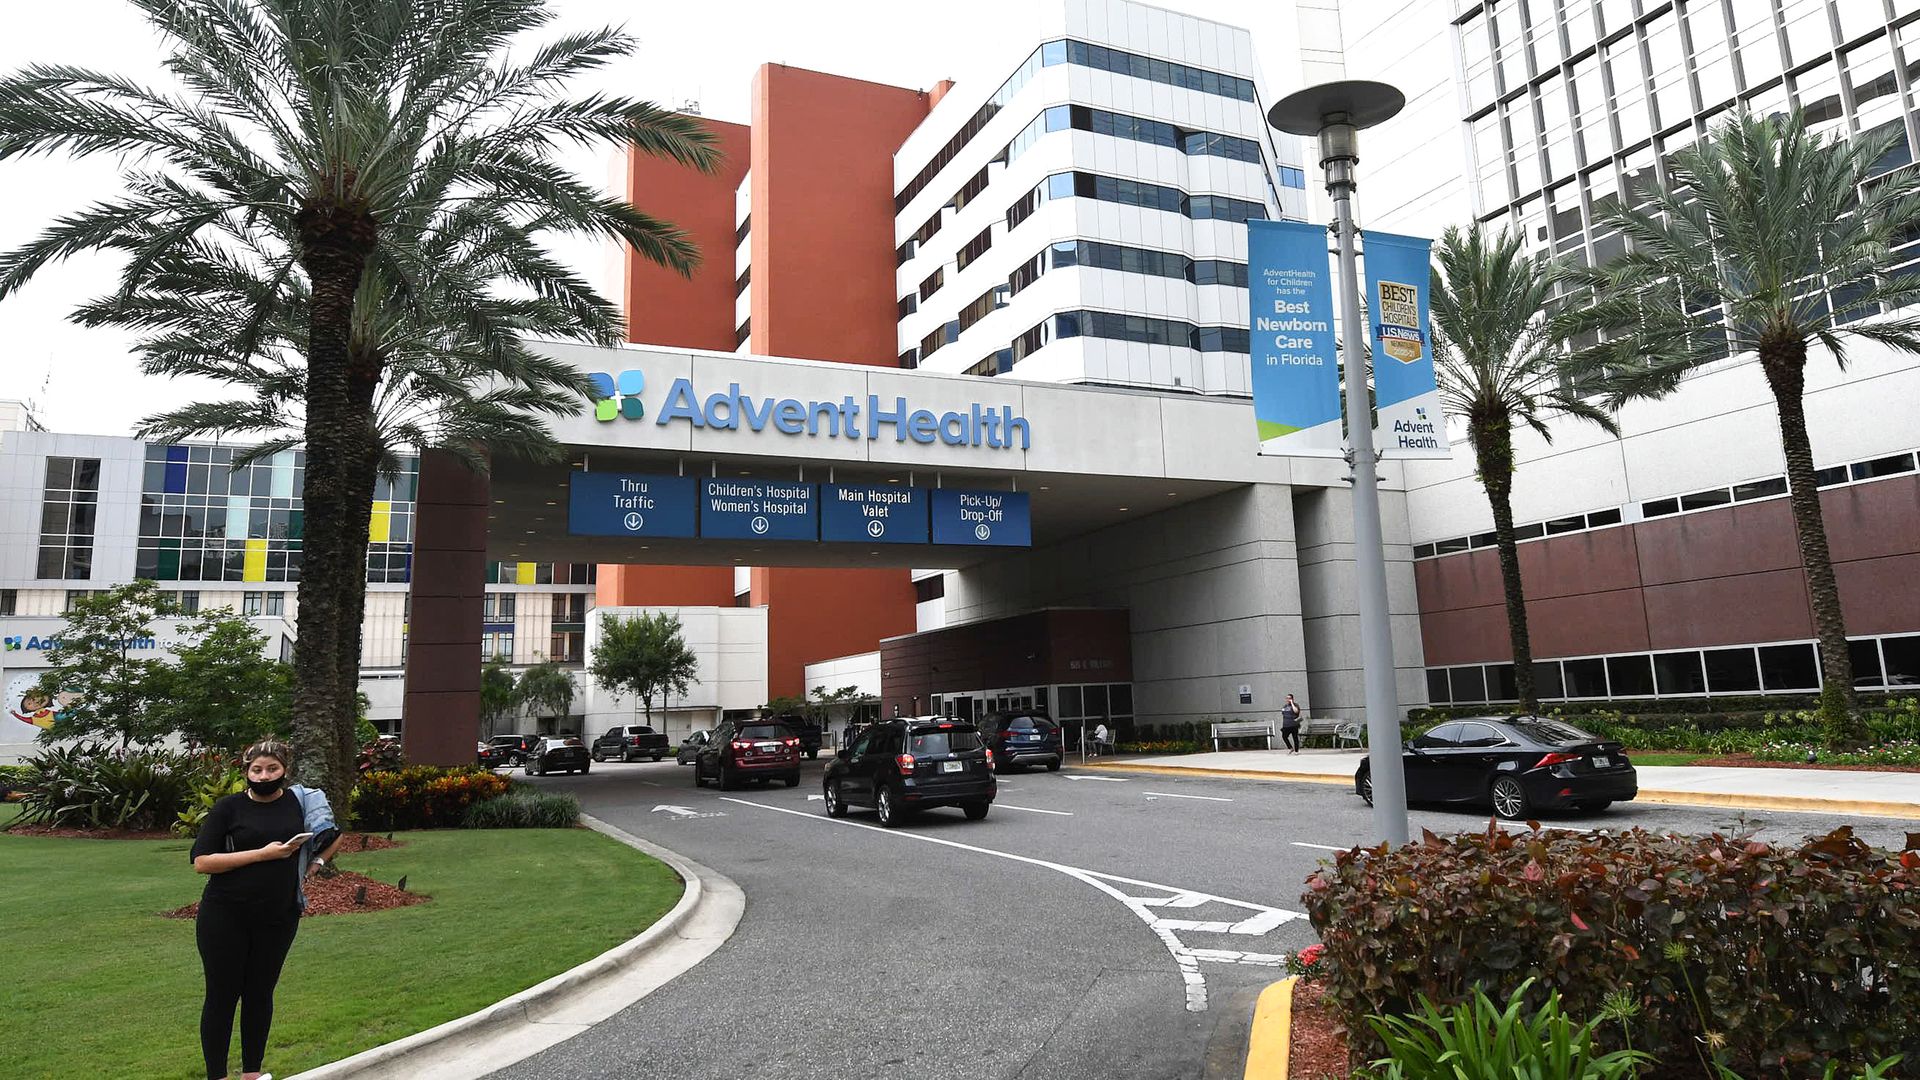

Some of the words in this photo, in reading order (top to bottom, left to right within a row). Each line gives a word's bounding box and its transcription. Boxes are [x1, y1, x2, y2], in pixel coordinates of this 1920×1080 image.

[1263, 268, 1316, 278] AdventHealth
[1267, 278, 1278, 286] for
[1280, 278, 1313, 287] Children
[1276, 287, 1291, 295] has
[1292, 287, 1306, 295] the
[1380, 284, 1416, 305] BEST
[1274, 299, 1311, 314] Best
[1256, 317, 1328, 332] Newborn
[1383, 312, 1418, 327] HOSPITALS
[1275, 334, 1313, 349] Care
[1266, 353, 1278, 366] in
[1281, 353, 1323, 366] Florida
[656, 378, 1031, 450] AdventHealth
[1393, 419, 1435, 434] Advent
[1398, 435, 1438, 449] Health
[620, 479, 648, 493] Thru
[708, 482, 763, 498] Children's
[766, 485, 810, 501] Hospital
[613, 494, 655, 509] Traffic
[838, 488, 864, 502] Main
[868, 490, 911, 504] Hospital
[960, 494, 1002, 508] Pick-Up/
[711, 498, 759, 513] Women's
[763, 500, 807, 516] Hospital
[862, 504, 889, 517] Valet
[960, 508, 1003, 523] Drop-Off
